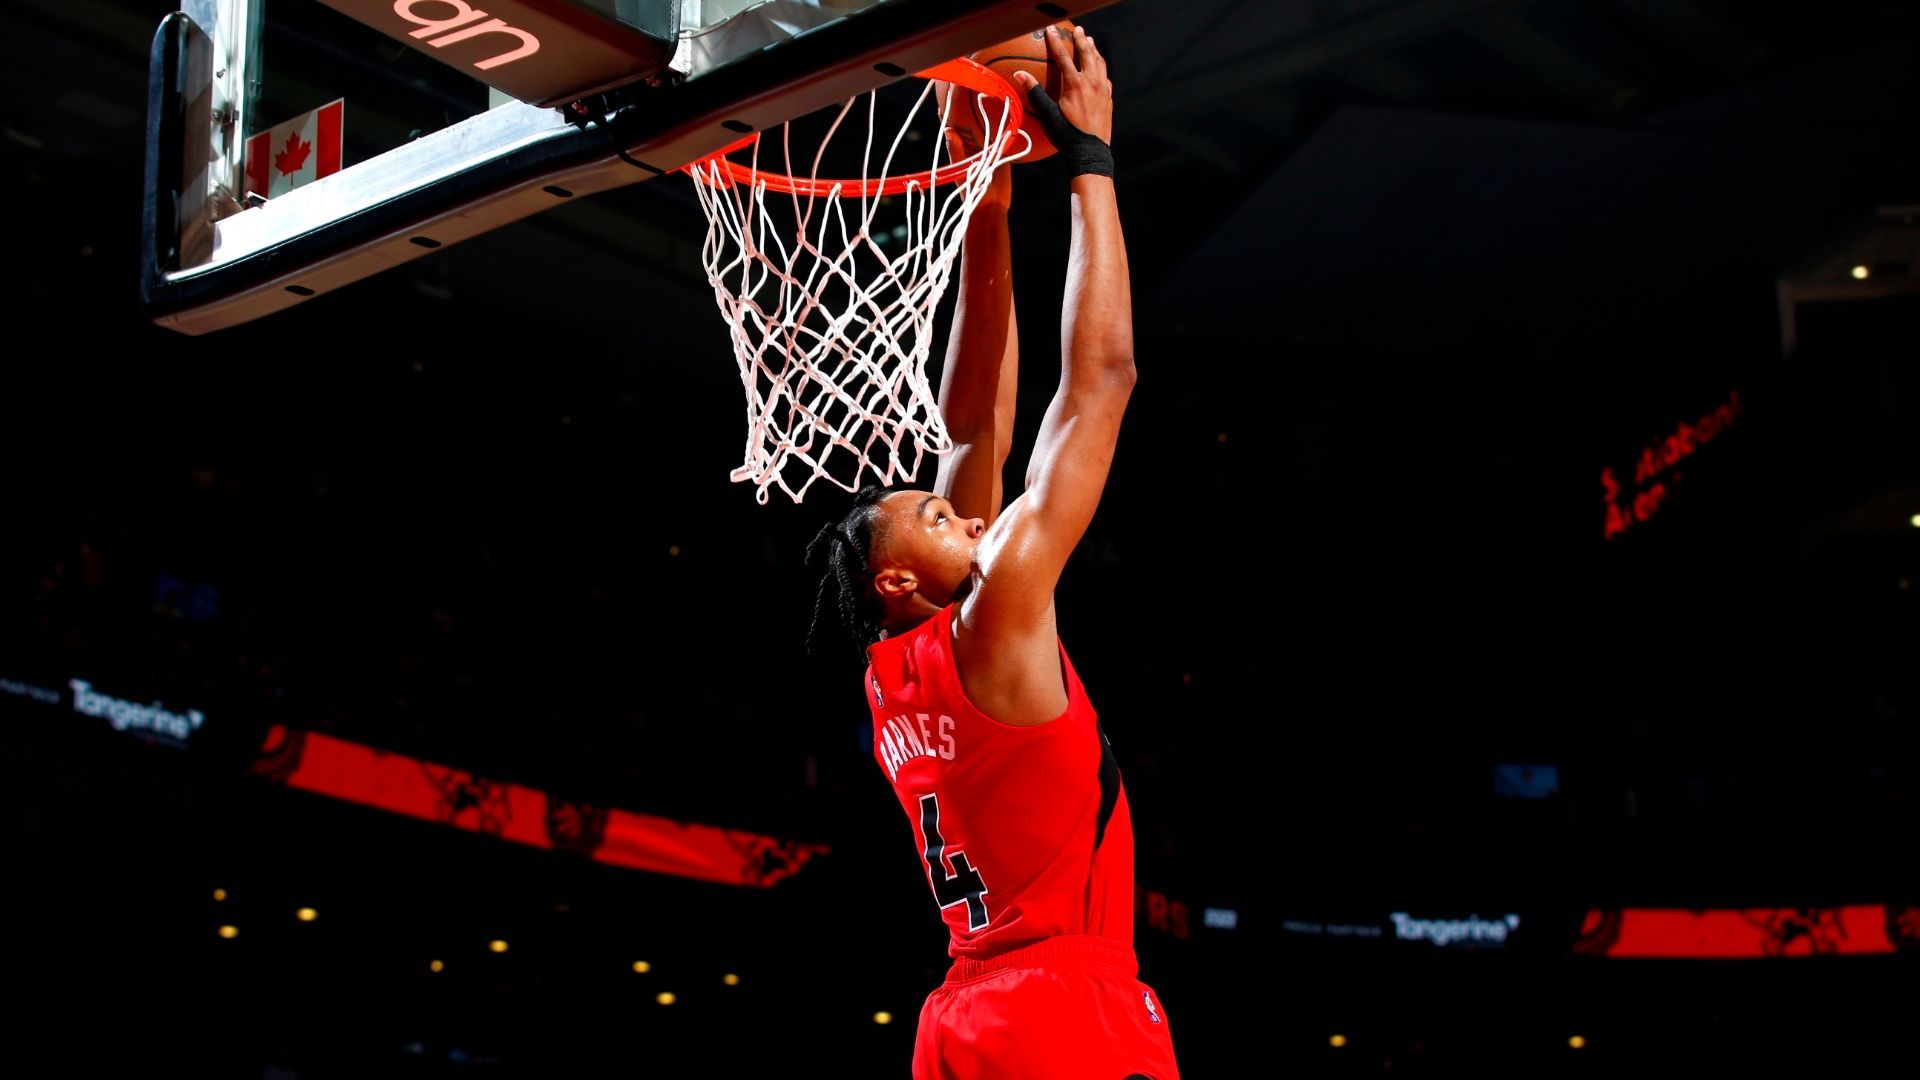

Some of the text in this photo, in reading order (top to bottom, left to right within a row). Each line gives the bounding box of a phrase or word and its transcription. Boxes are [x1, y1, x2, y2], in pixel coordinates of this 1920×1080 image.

[67, 676, 191, 741] Tangerine
[918, 792, 990, 932] 4
[1388, 910, 1509, 948] Tangerine
